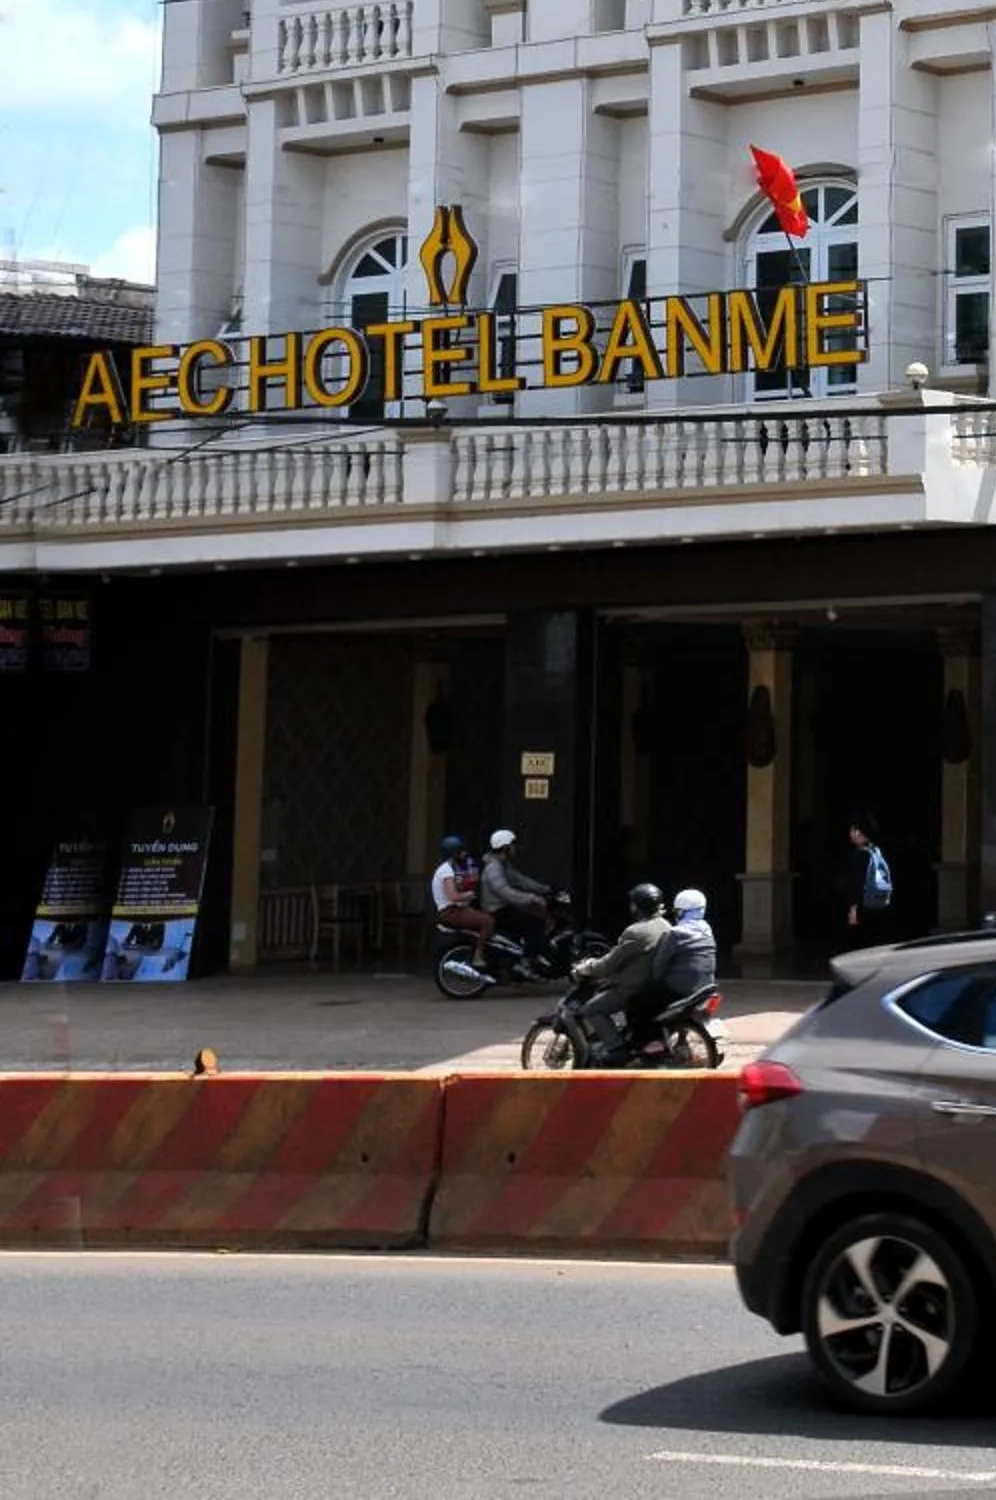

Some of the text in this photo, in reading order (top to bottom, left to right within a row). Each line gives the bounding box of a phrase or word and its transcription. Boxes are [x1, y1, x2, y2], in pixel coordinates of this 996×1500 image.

[72, 280, 868, 428] AEC HOTEL BANME
